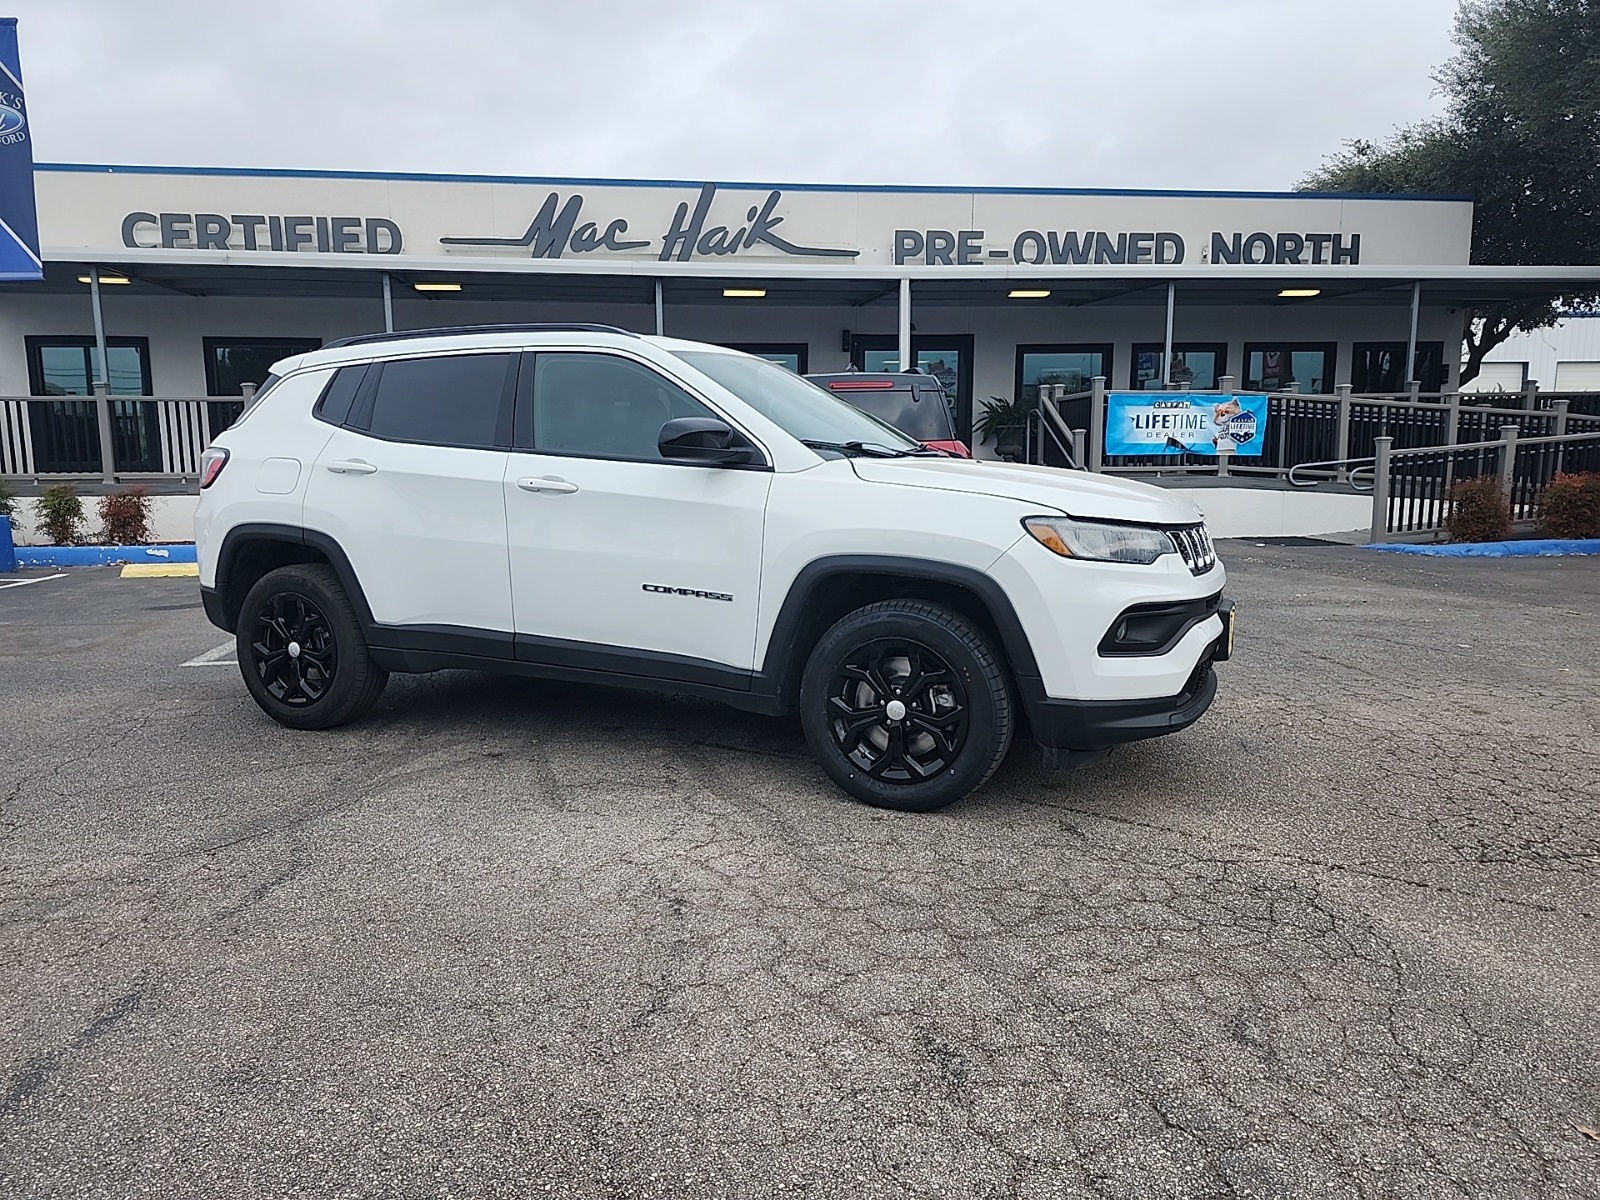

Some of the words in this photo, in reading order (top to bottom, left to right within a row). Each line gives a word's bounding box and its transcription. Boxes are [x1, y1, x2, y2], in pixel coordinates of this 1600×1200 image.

[439, 192, 650, 259] Mac
[658, 182, 860, 262] Haik
[121, 211, 403, 255] CERTIFIED
[893, 229, 1185, 266] PRE-OWNED
[1210, 232, 1361, 266] NORTH
[1153, 401, 1191, 409] CARFAX
[1135, 414, 1208, 430] LIFETIME
[1146, 431, 1196, 439] DEALER
[641, 583, 734, 602] COMPASS
